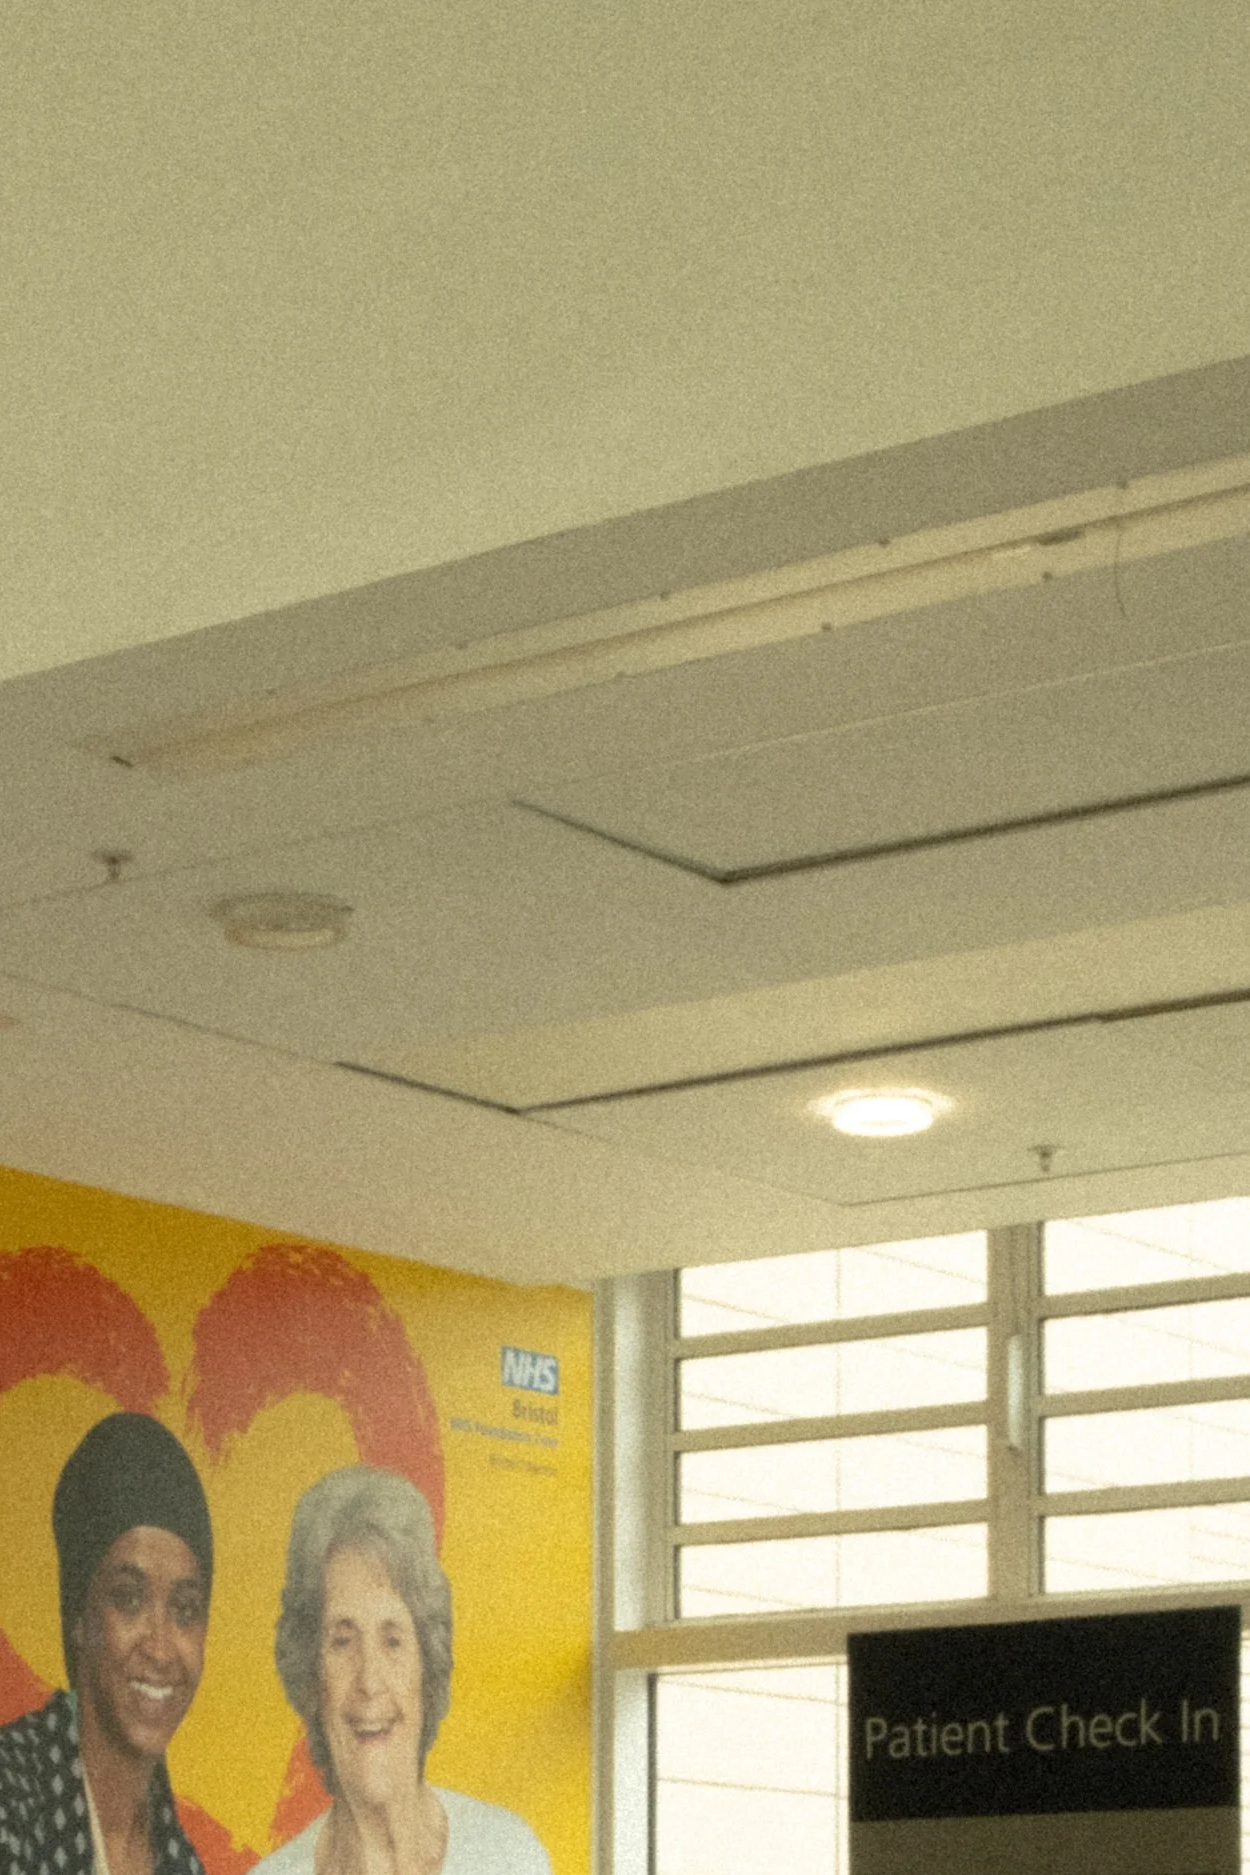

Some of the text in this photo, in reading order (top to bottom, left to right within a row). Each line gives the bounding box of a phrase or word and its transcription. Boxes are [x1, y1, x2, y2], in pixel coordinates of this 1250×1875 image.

[502, 1347, 557, 1393] NHS
[865, 1701, 1220, 1759] Patient Check In
